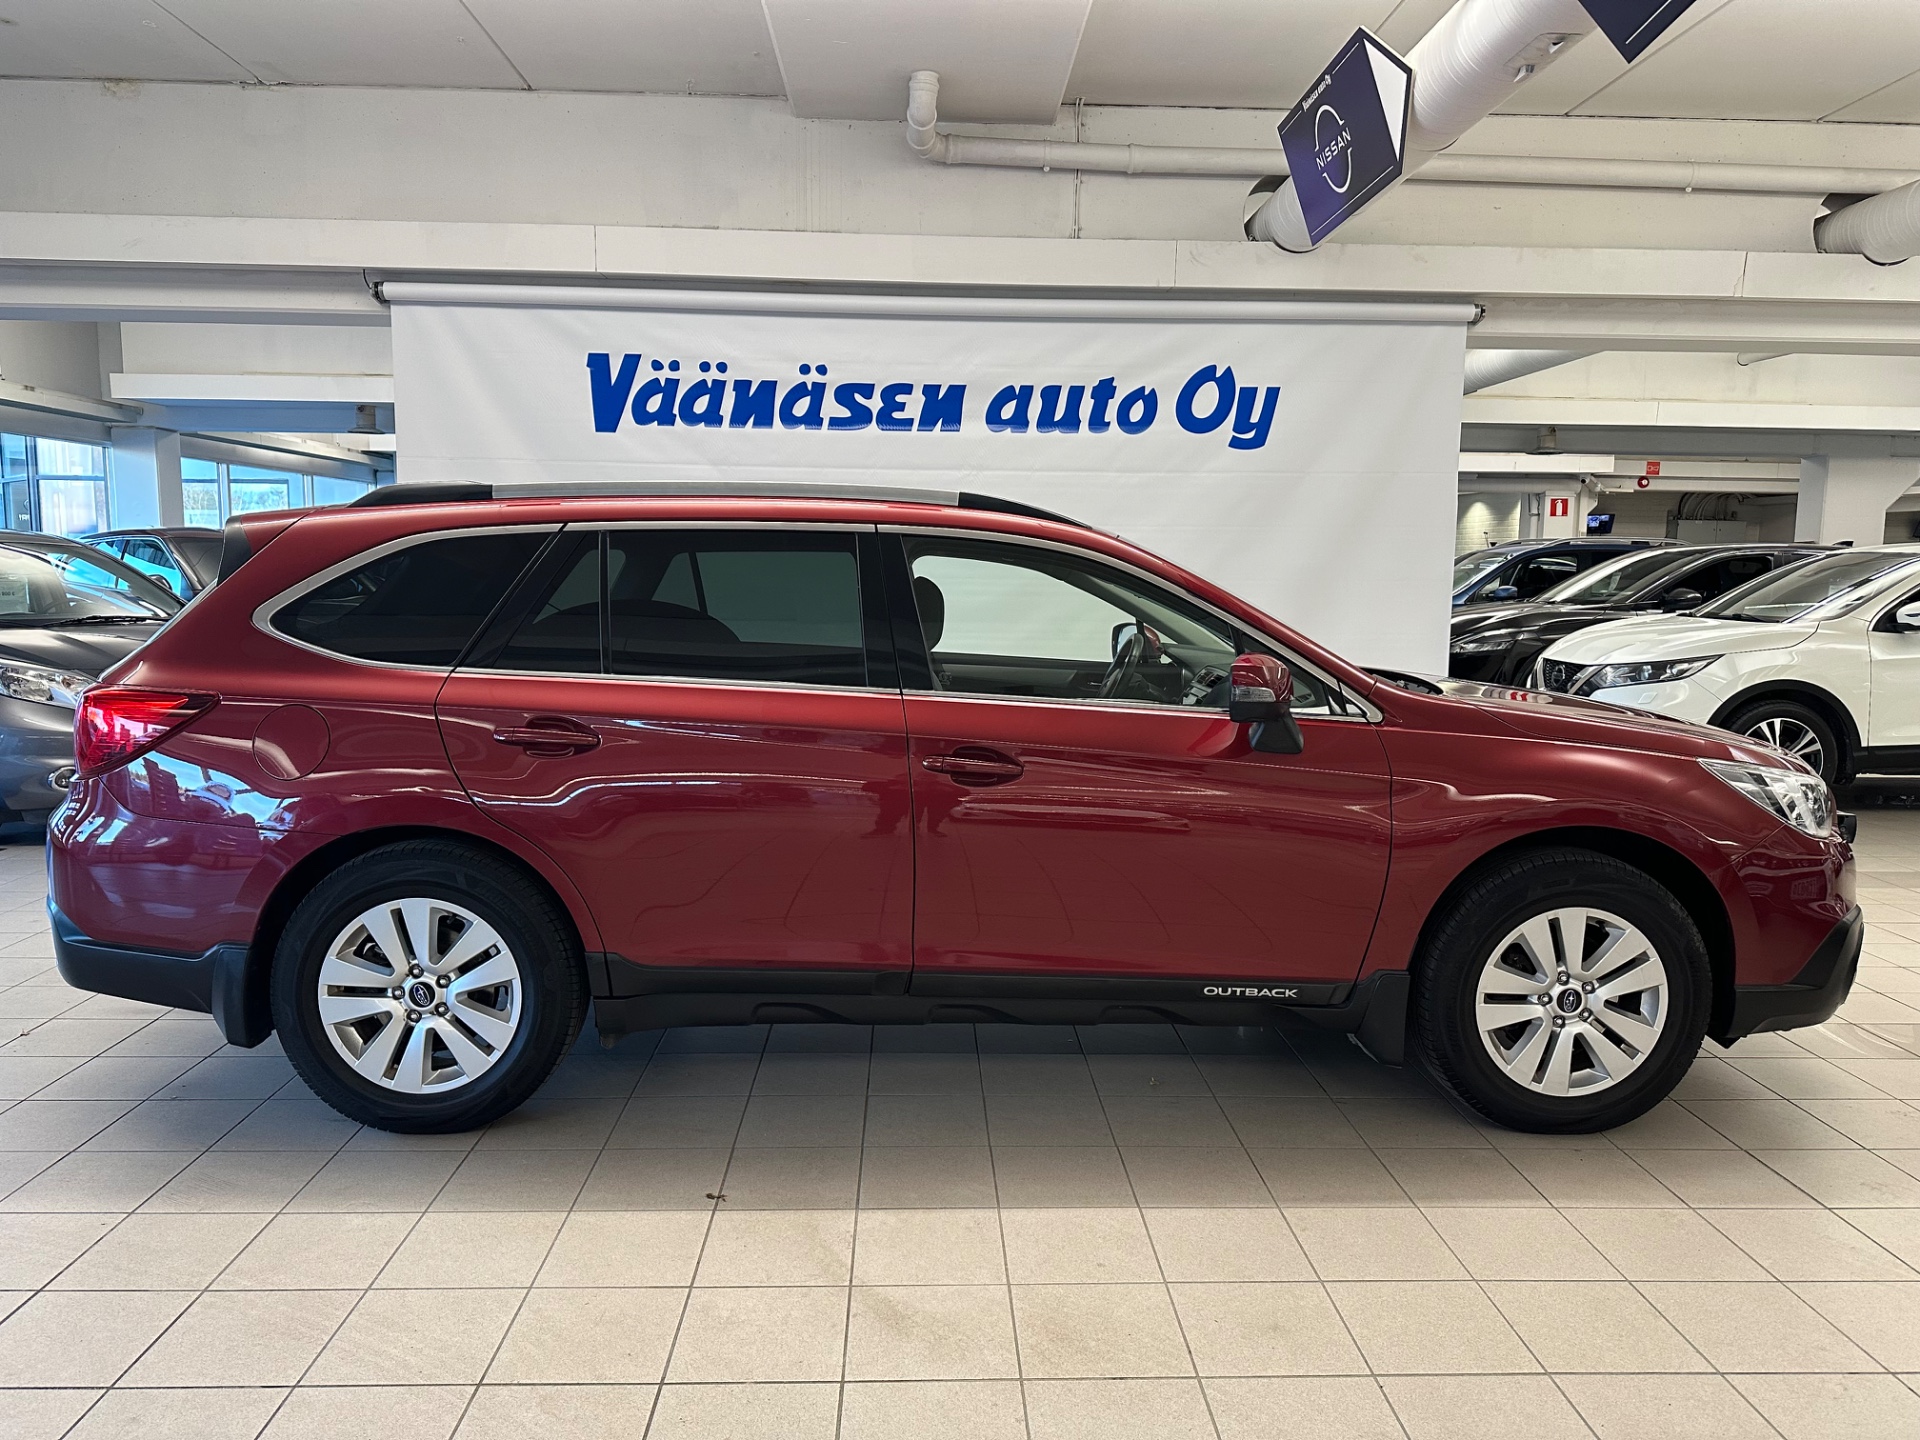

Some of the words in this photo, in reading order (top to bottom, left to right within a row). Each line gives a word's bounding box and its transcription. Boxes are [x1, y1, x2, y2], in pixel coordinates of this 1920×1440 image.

[1315, 127, 1351, 170] NISSAN
[587, 353, 966, 433] Väänäsen
[985, 378, 1157, 434] auto
[1176, 365, 1280, 450] Oy
[1203, 986, 1298, 998] OUTBACK
